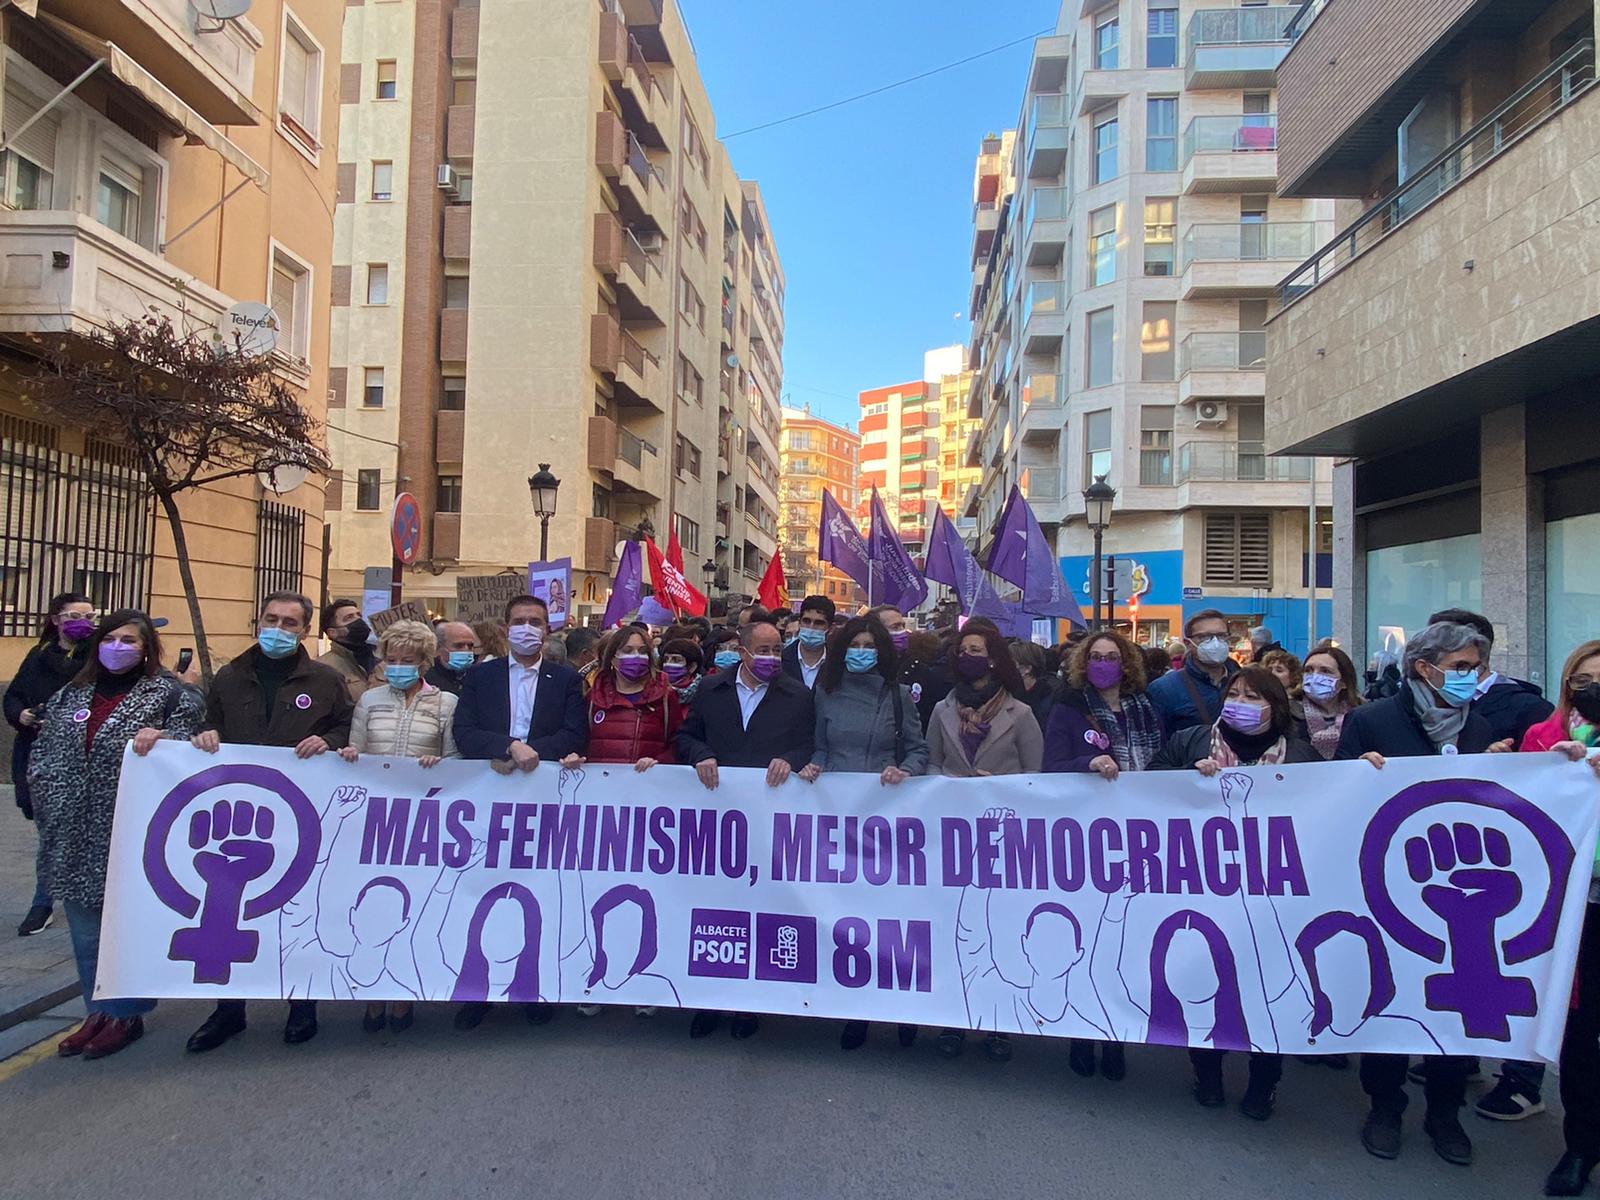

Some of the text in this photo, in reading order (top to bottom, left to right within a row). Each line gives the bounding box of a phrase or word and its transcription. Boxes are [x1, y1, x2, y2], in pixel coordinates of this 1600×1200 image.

[358, 787, 1310, 896] MÁS FEMINISMO, MEJOR DEMOCRACIA
[692, 939, 747, 964] PSOE
[694, 924, 747, 938] ALBACETE
[832, 916, 932, 993] 8M
